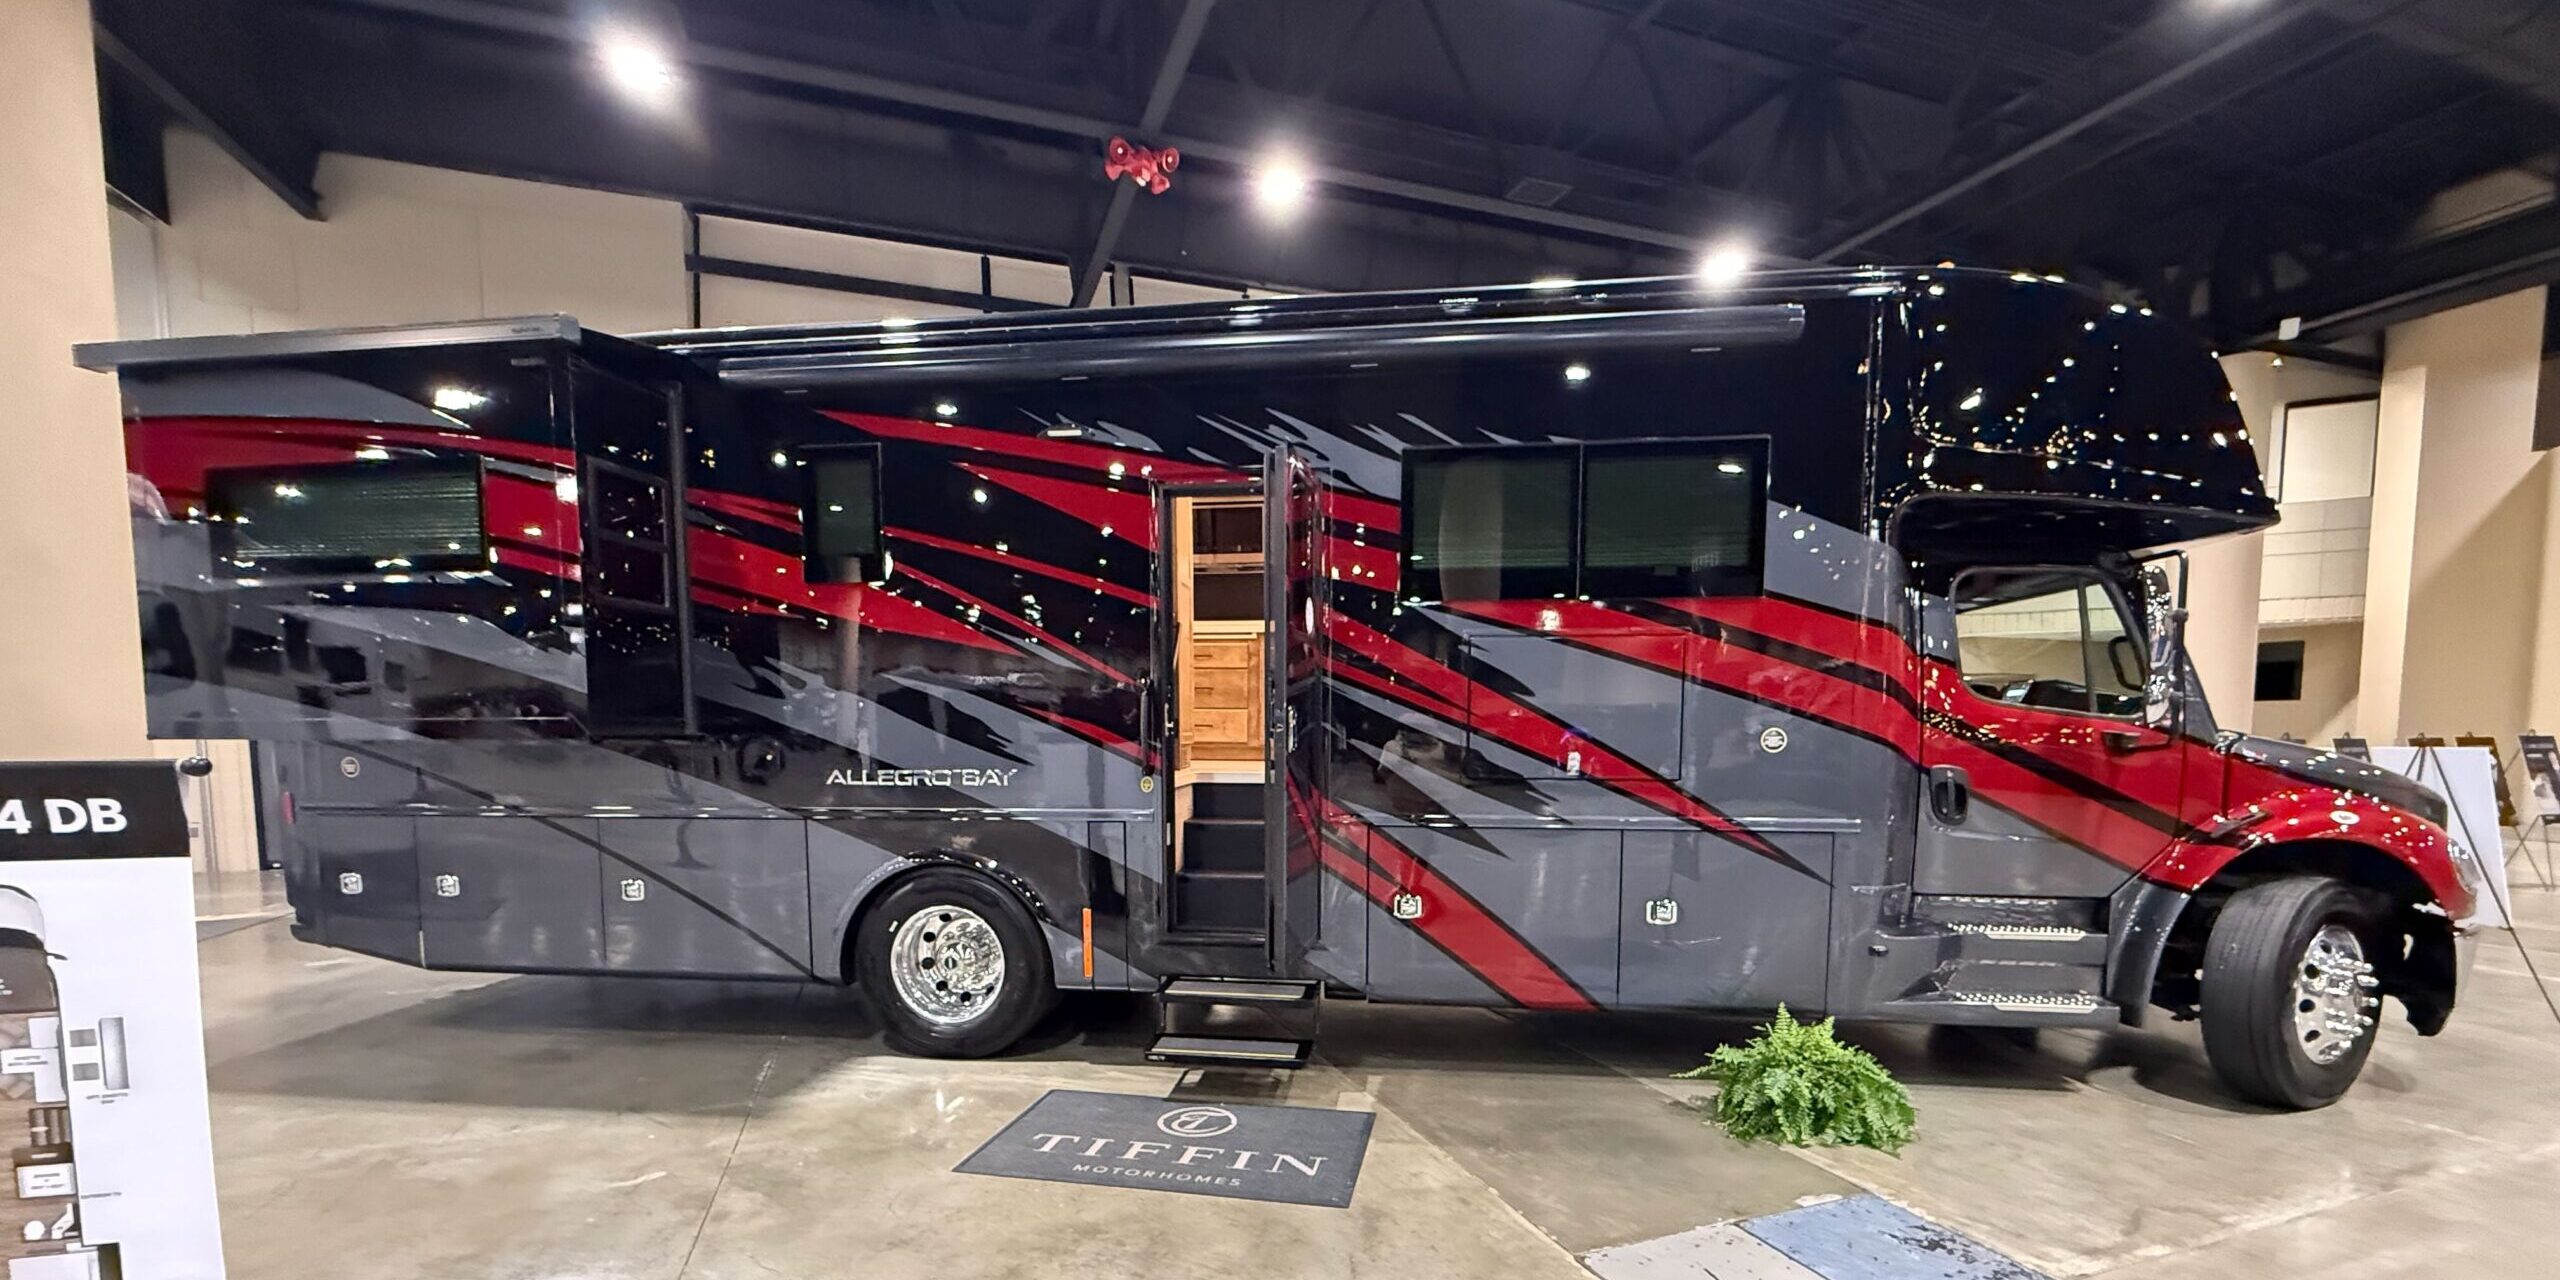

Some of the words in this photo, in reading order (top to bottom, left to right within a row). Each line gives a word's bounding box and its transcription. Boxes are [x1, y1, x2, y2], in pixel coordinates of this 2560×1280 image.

[823, 767, 952, 787] ALLEGRO
[961, 767, 1019, 787] BAY
[0, 799, 32, 835] 4
[43, 797, 128, 834] DB
[1032, 1132, 1328, 1176] TIFFIN
[1071, 1163, 1243, 1187] MOTORHOMES
